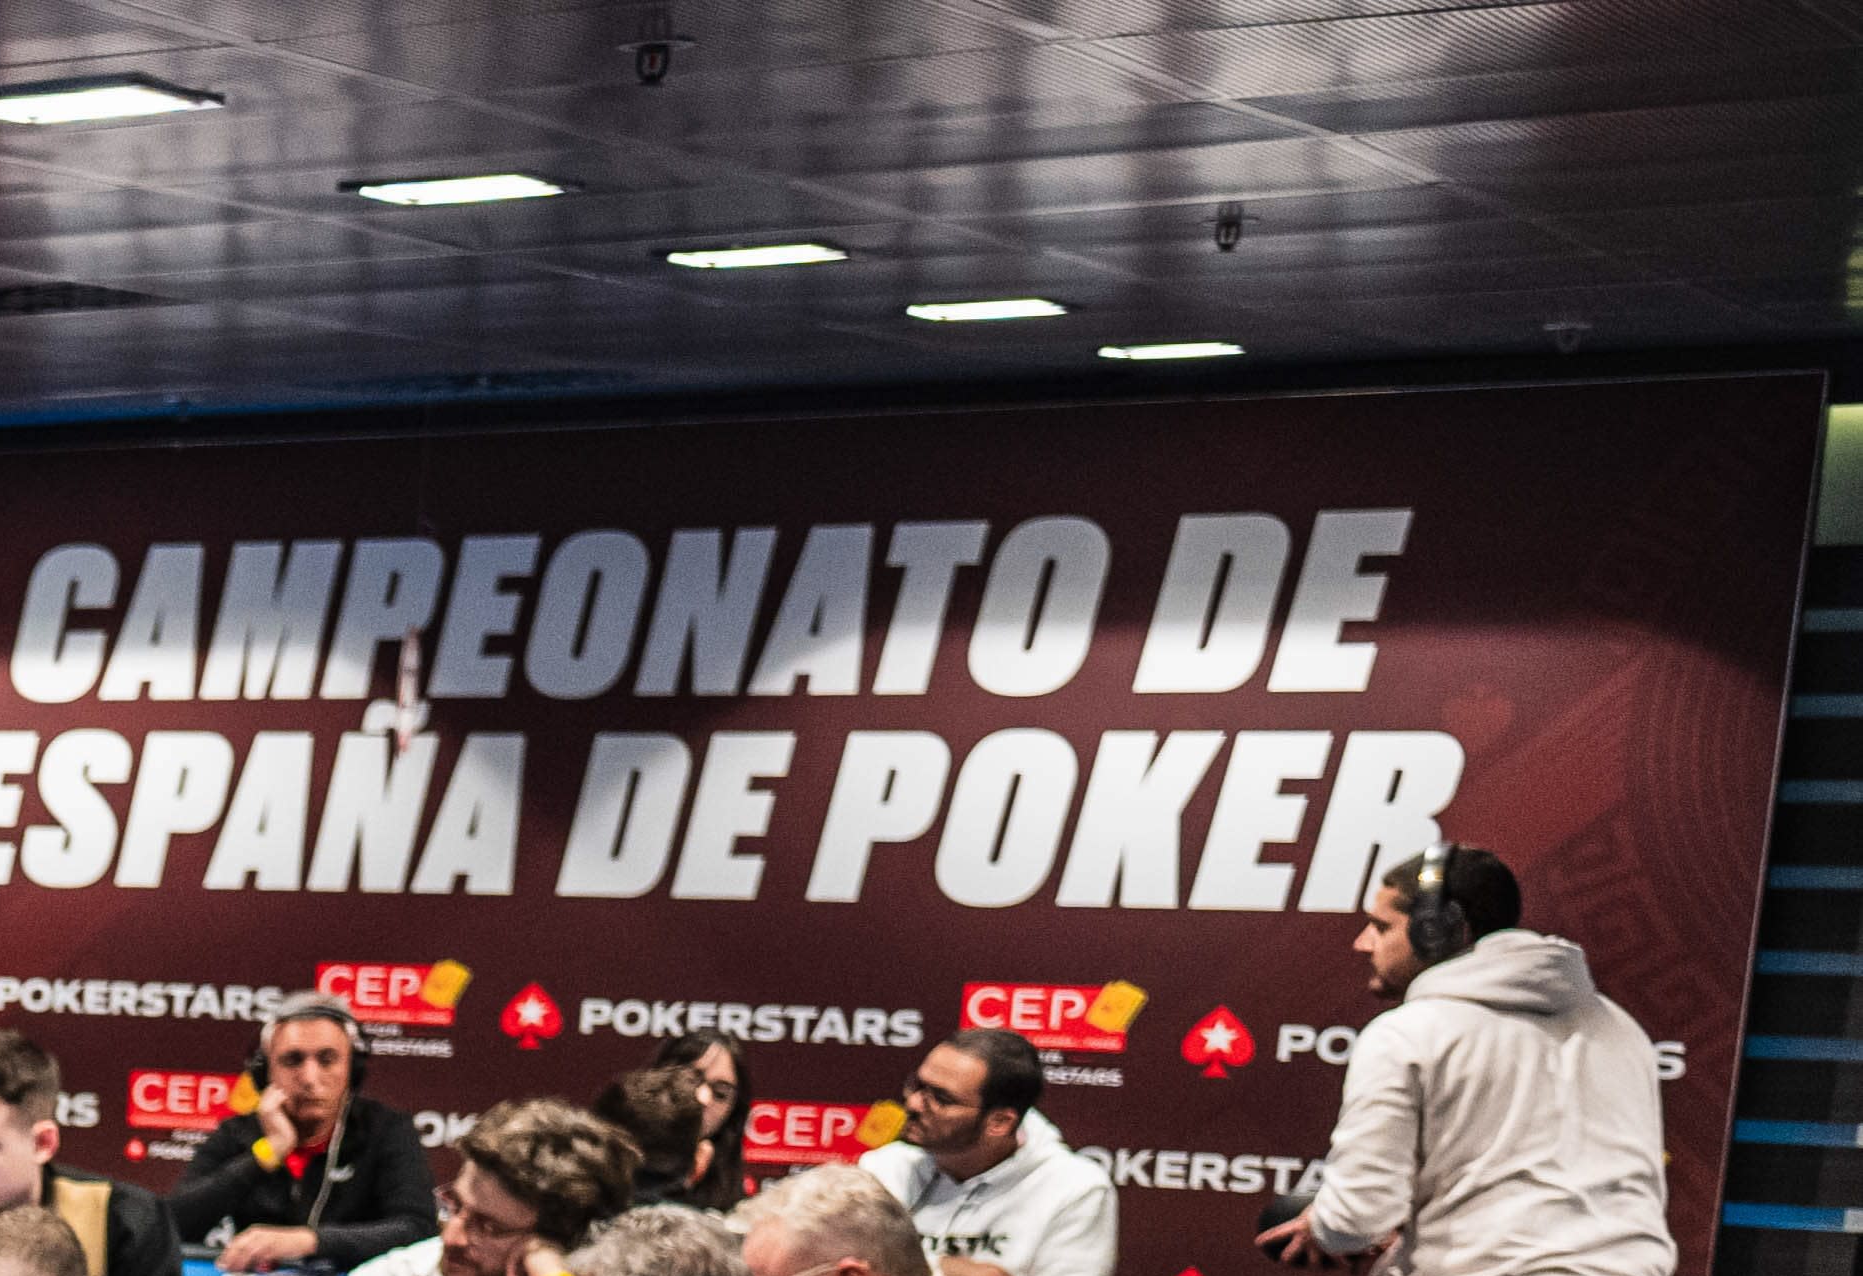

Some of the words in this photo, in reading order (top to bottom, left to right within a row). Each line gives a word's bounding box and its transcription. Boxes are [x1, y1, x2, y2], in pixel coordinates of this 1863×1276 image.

[9, 514, 1111, 704] CAMPEONATO
[1132, 509, 1415, 694] DE
[554, 730, 798, 902] DE
[804, 726, 1466, 914] POKER
[318, 964, 421, 1007] CEP
[967, 985, 1088, 1031] CEP
[579, 998, 924, 1047] POKERSTARS
[132, 1072, 229, 1114] CEP
[744, 1103, 857, 1148] CEP
